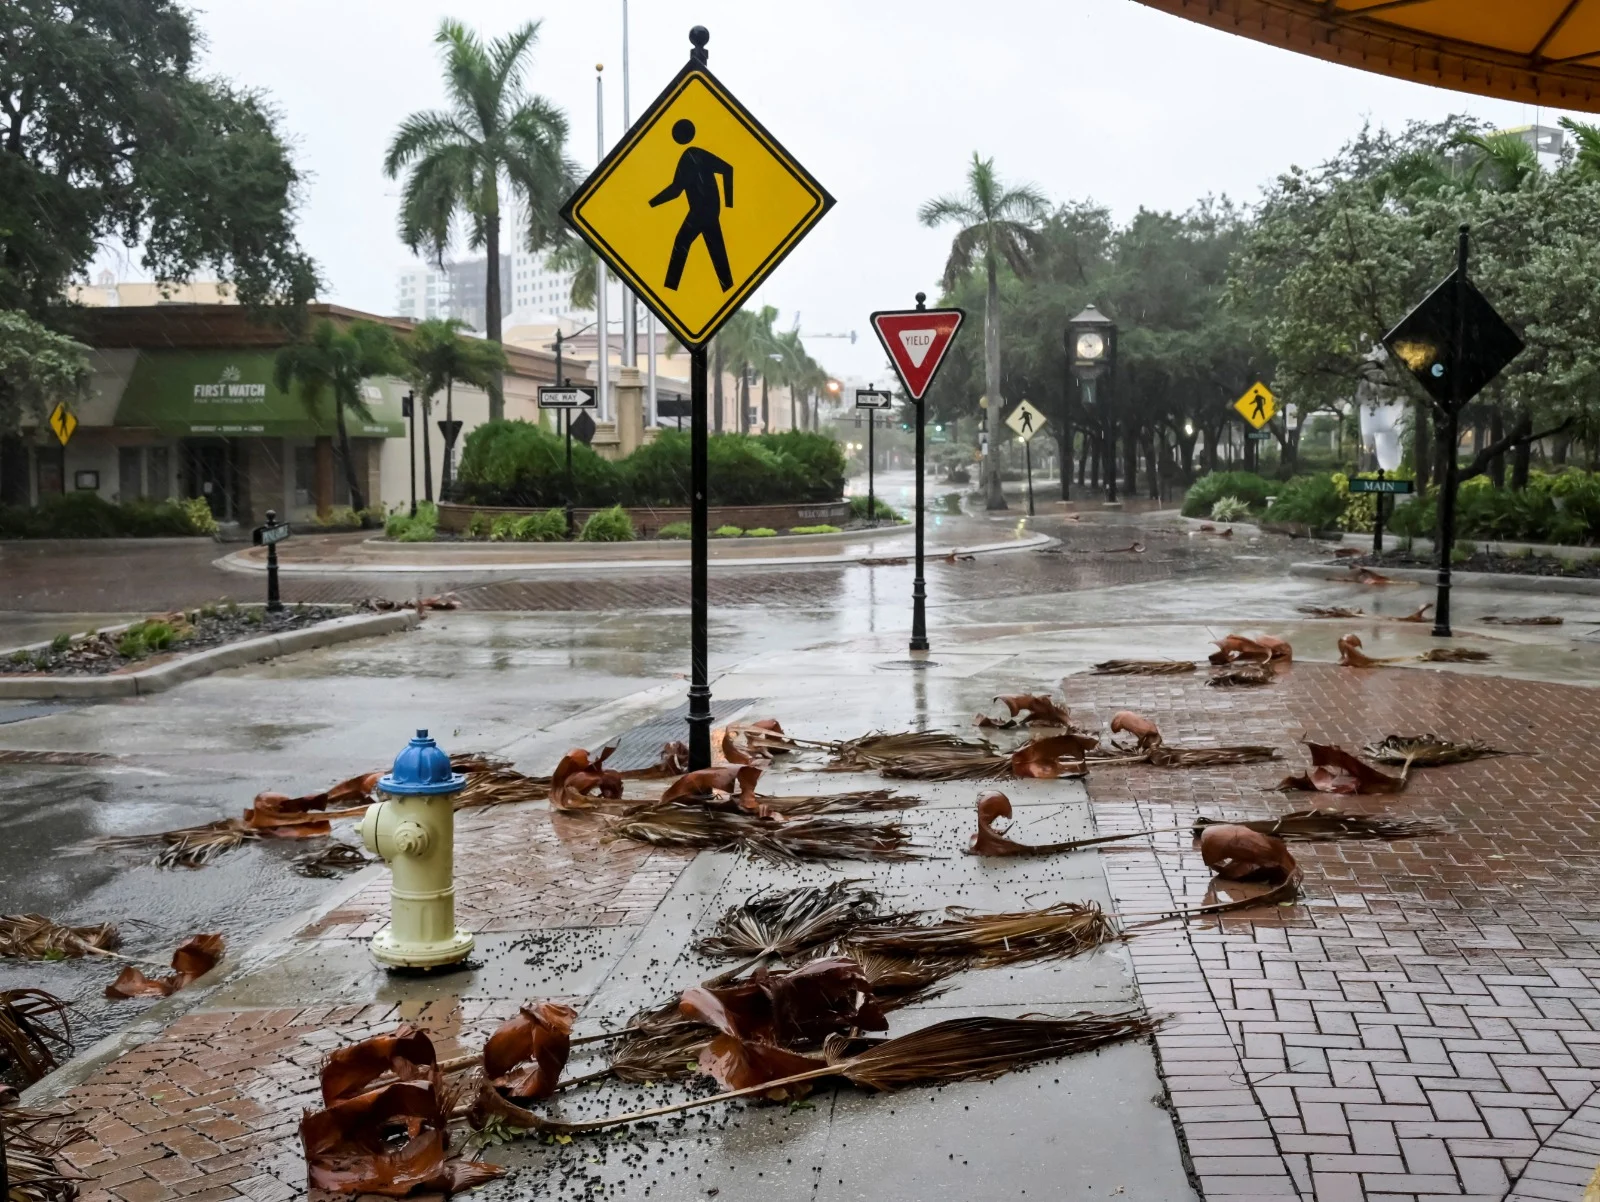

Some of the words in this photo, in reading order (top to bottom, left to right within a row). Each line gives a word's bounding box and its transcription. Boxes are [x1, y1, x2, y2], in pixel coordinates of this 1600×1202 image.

[905, 335, 930, 346] YIELD
[194, 383, 225, 397] FIRST
[228, 383, 265, 397] WATCH
[1364, 480, 1395, 491] MAIN
